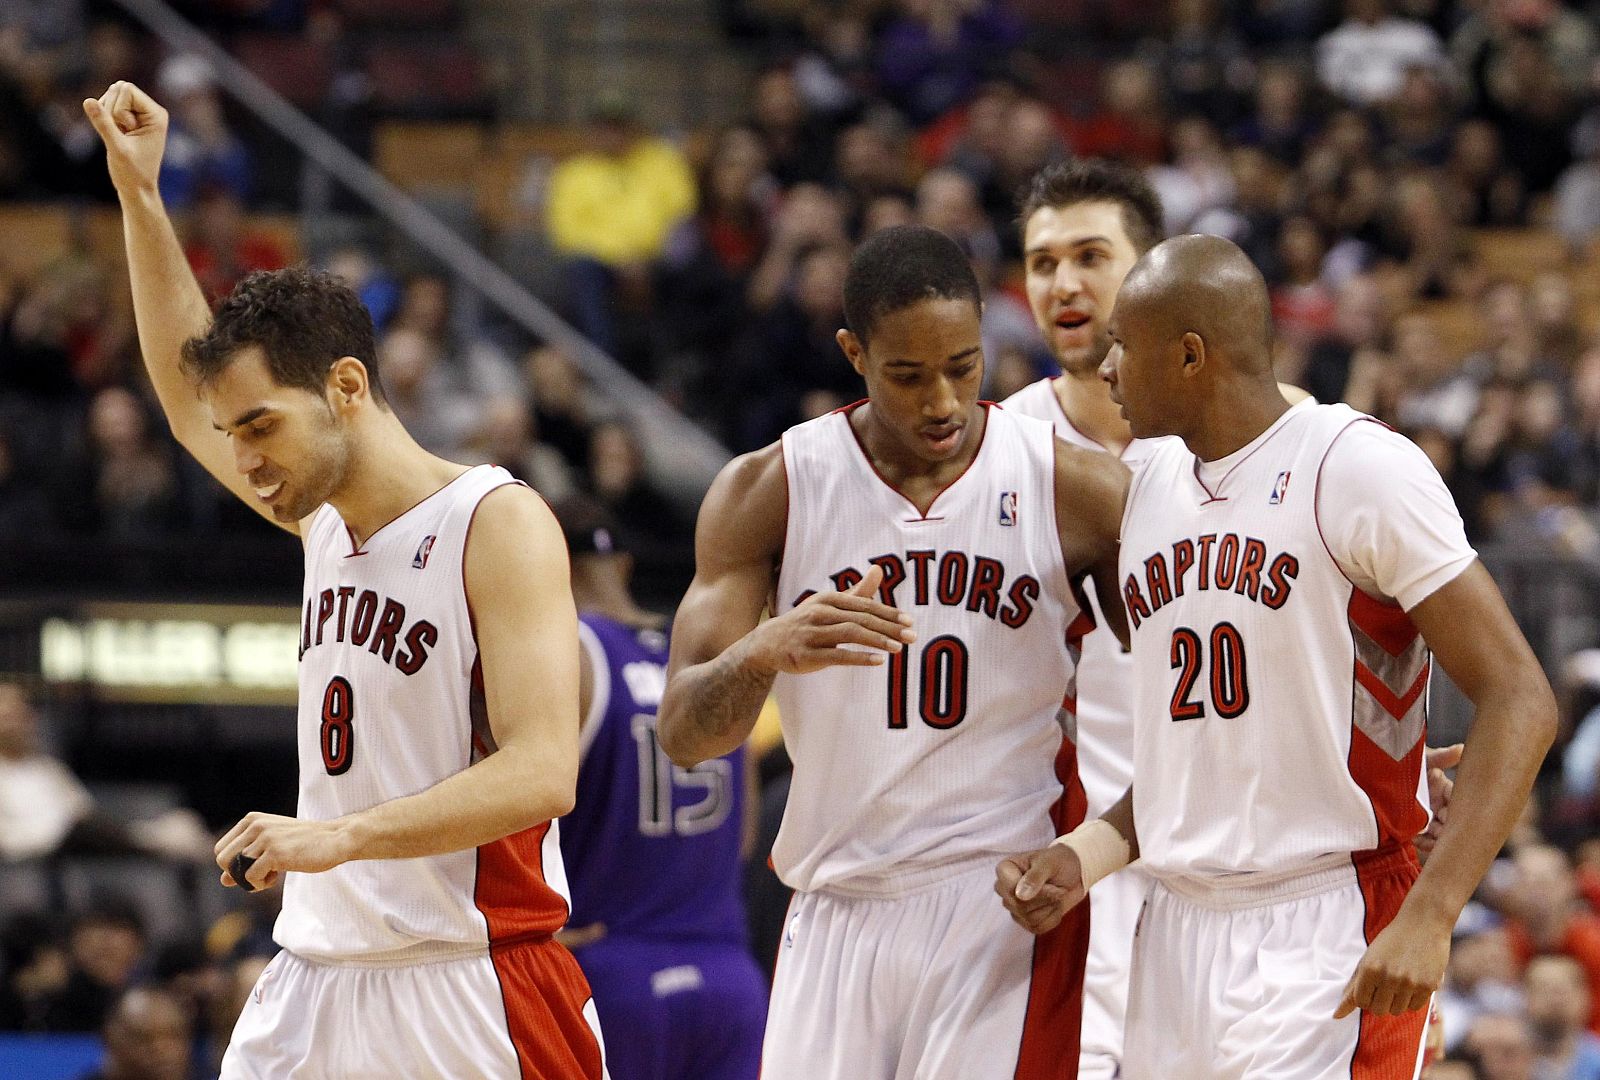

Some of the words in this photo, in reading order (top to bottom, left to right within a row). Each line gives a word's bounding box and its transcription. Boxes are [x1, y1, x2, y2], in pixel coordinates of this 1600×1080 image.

[792, 549, 1040, 629] PTORS
[1124, 533, 1300, 630] RAPTORS
[298, 586, 439, 676] APTORS
[1170, 621, 1250, 722] 20
[320, 675, 354, 776] 8
[887, 634, 969, 729] 10
[630, 713, 734, 837] 15
